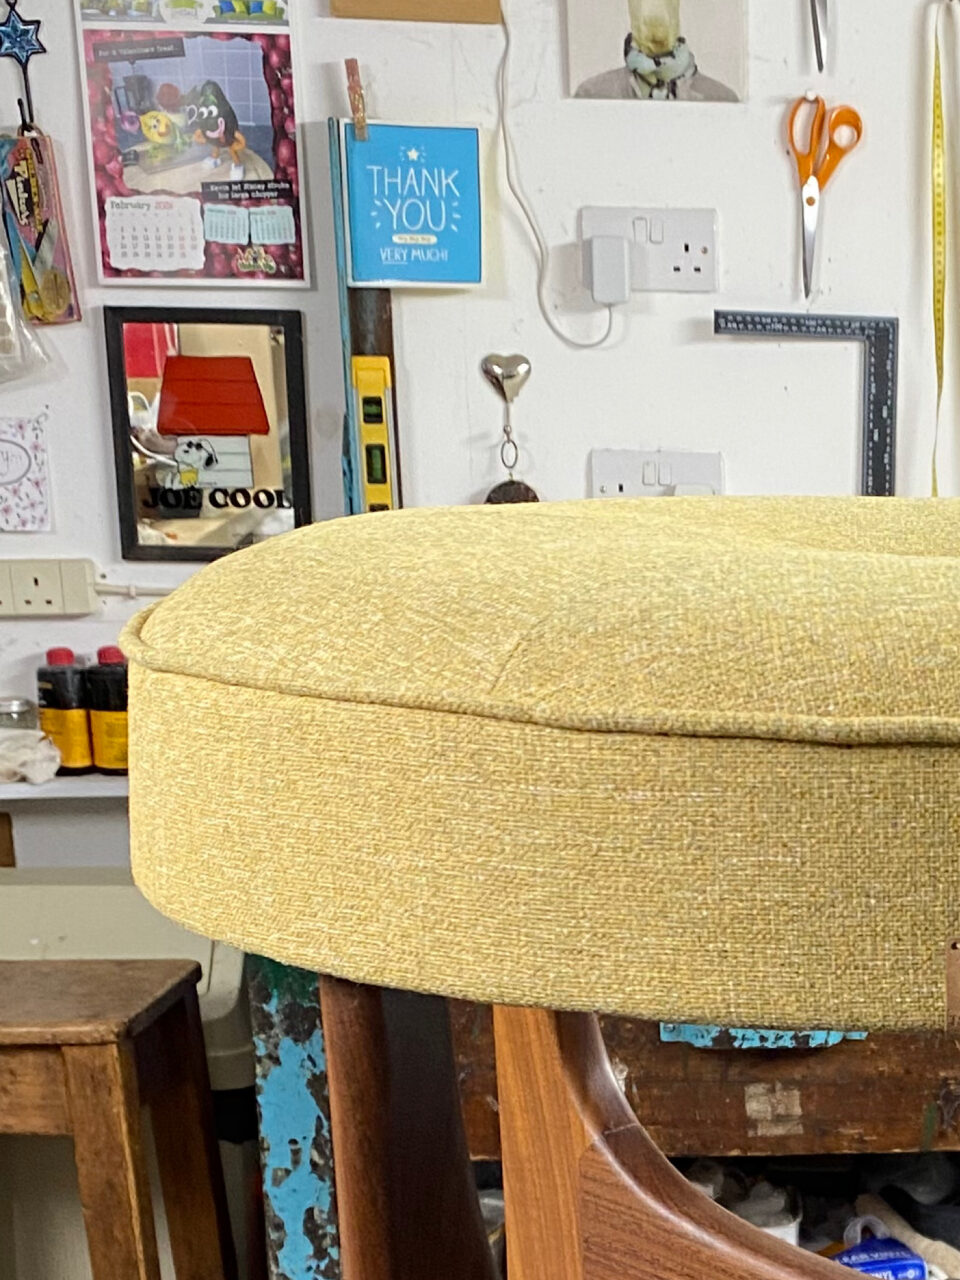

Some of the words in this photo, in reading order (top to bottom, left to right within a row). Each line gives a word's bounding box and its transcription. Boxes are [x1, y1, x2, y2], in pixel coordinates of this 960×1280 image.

[366, 165, 460, 198] THANK
[383, 198, 446, 232] YOU
[380, 247, 408, 262] VERY
[142, 487, 203, 509] JOE
[208, 487, 292, 509] COOL
